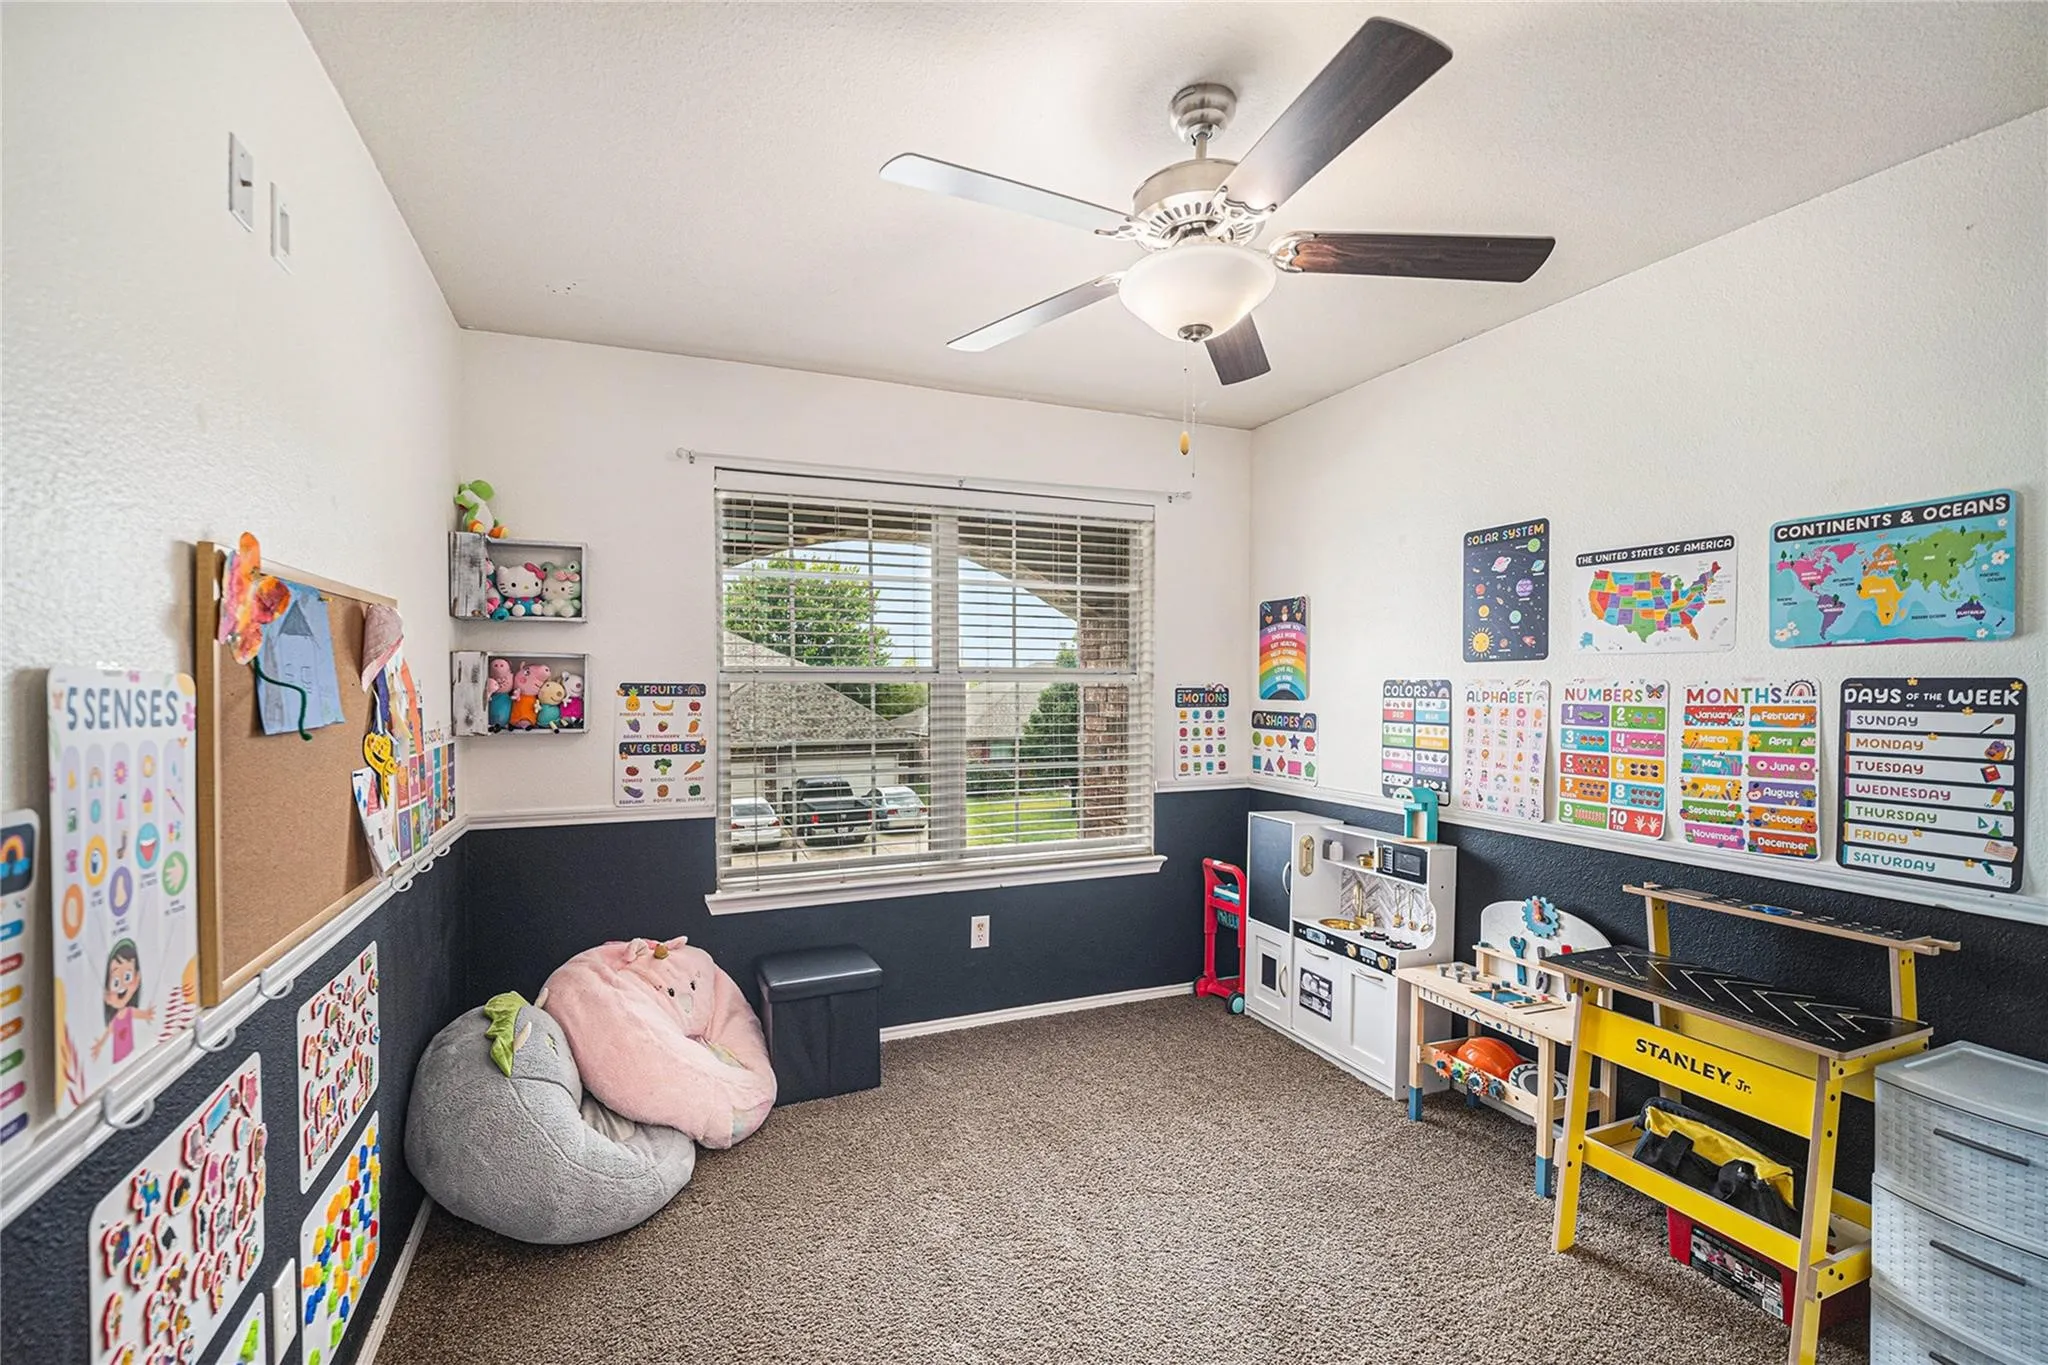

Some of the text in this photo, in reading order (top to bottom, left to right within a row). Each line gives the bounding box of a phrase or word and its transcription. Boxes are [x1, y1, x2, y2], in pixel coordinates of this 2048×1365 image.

[1776, 496, 2007, 540] CONTINENTS & OCEANS
[1466, 523, 1545, 546] SOLAR SYSTEM
[1577, 538, 1732, 565] THE UNITED STATES OF AMERICA
[643, 685, 684, 694] FRUITS
[1384, 685, 1428, 697] COLORS
[1564, 688, 1643, 702] NUMBERS
[1686, 688, 1782, 704] MONTHS
[1177, 693, 1228, 704] EMOTIONS
[1466, 691, 1533, 704] ALPHABET
[1844, 688, 2020, 706] DAYS OF THE WEEK
[66, 686, 179, 730] 5 SENSES
[1567, 705, 1574, 718] 1
[1616, 707, 1625, 721] 2
[1265, 714, 1300, 728] SHAPES
[1694, 711, 1733, 720] January
[1761, 711, 1806, 721] February
[1856, 715, 1919, 726] SUNDAY
[1566, 730, 1574, 743] 3
[1616, 733, 1625, 747] 4
[1698, 734, 1728, 743] March
[1768, 736, 1793, 746] April
[629, 743, 697, 753] VEGETABLES
[1856, 737, 1924, 751] MONDAY
[1566, 755, 1573, 767] 5
[1616, 758, 1625, 772] 6
[1701, 759, 1722, 769] May
[1769, 762, 1795, 772] June
[1856, 760, 1924, 775] TUESDAY
[1615, 784, 1625, 798] 8
[1763, 787, 1800, 799] August
[1856, 783, 1951, 801] WEDNESDAY
[1564, 803, 1573, 816] 9
[1688, 805, 1737, 818] September
[1856, 806, 1938, 823] THURSDAY
[1611, 810, 1627, 825] 10
[1761, 812, 1804, 824] October
[1692, 829, 1739, 842] November
[1854, 828, 1909, 844] FRIDAY
[1757, 837, 1809, 850] December
[1853, 851, 1936, 872] SATURDAY
[1635, 1038, 1752, 1095] STANLEY Jr.
